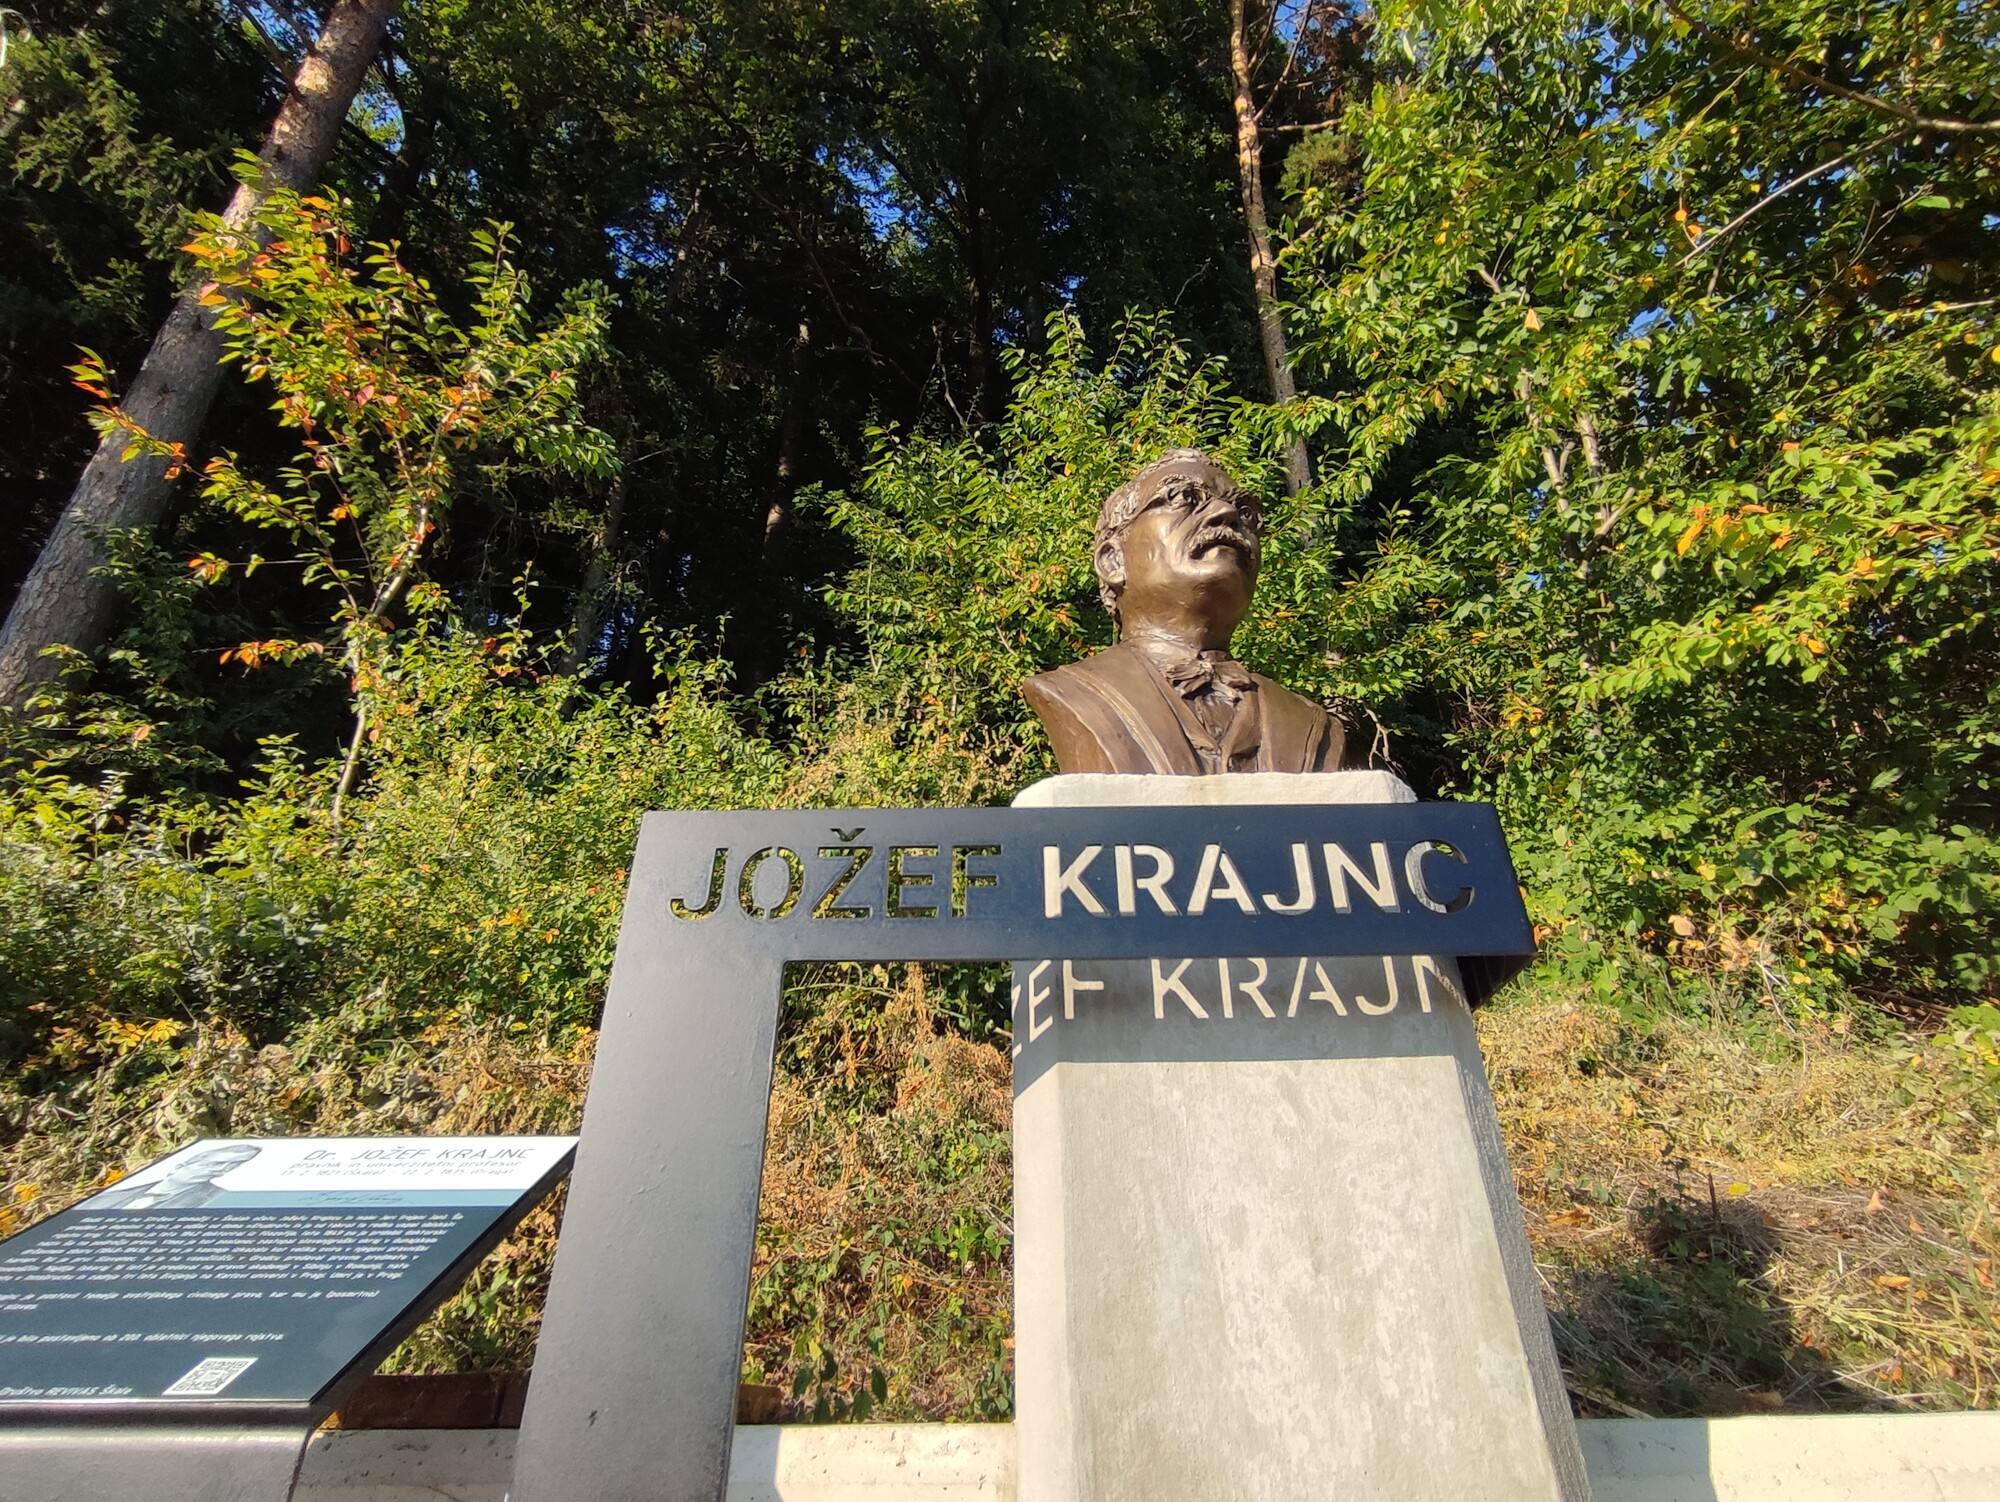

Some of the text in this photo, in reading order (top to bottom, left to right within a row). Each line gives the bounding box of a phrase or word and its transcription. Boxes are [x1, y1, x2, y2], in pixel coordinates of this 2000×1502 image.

[670, 828, 1475, 921] JOŽEF KRAJNC
[303, 1145, 535, 1161] Dr. JOŽEF KRAJNC
